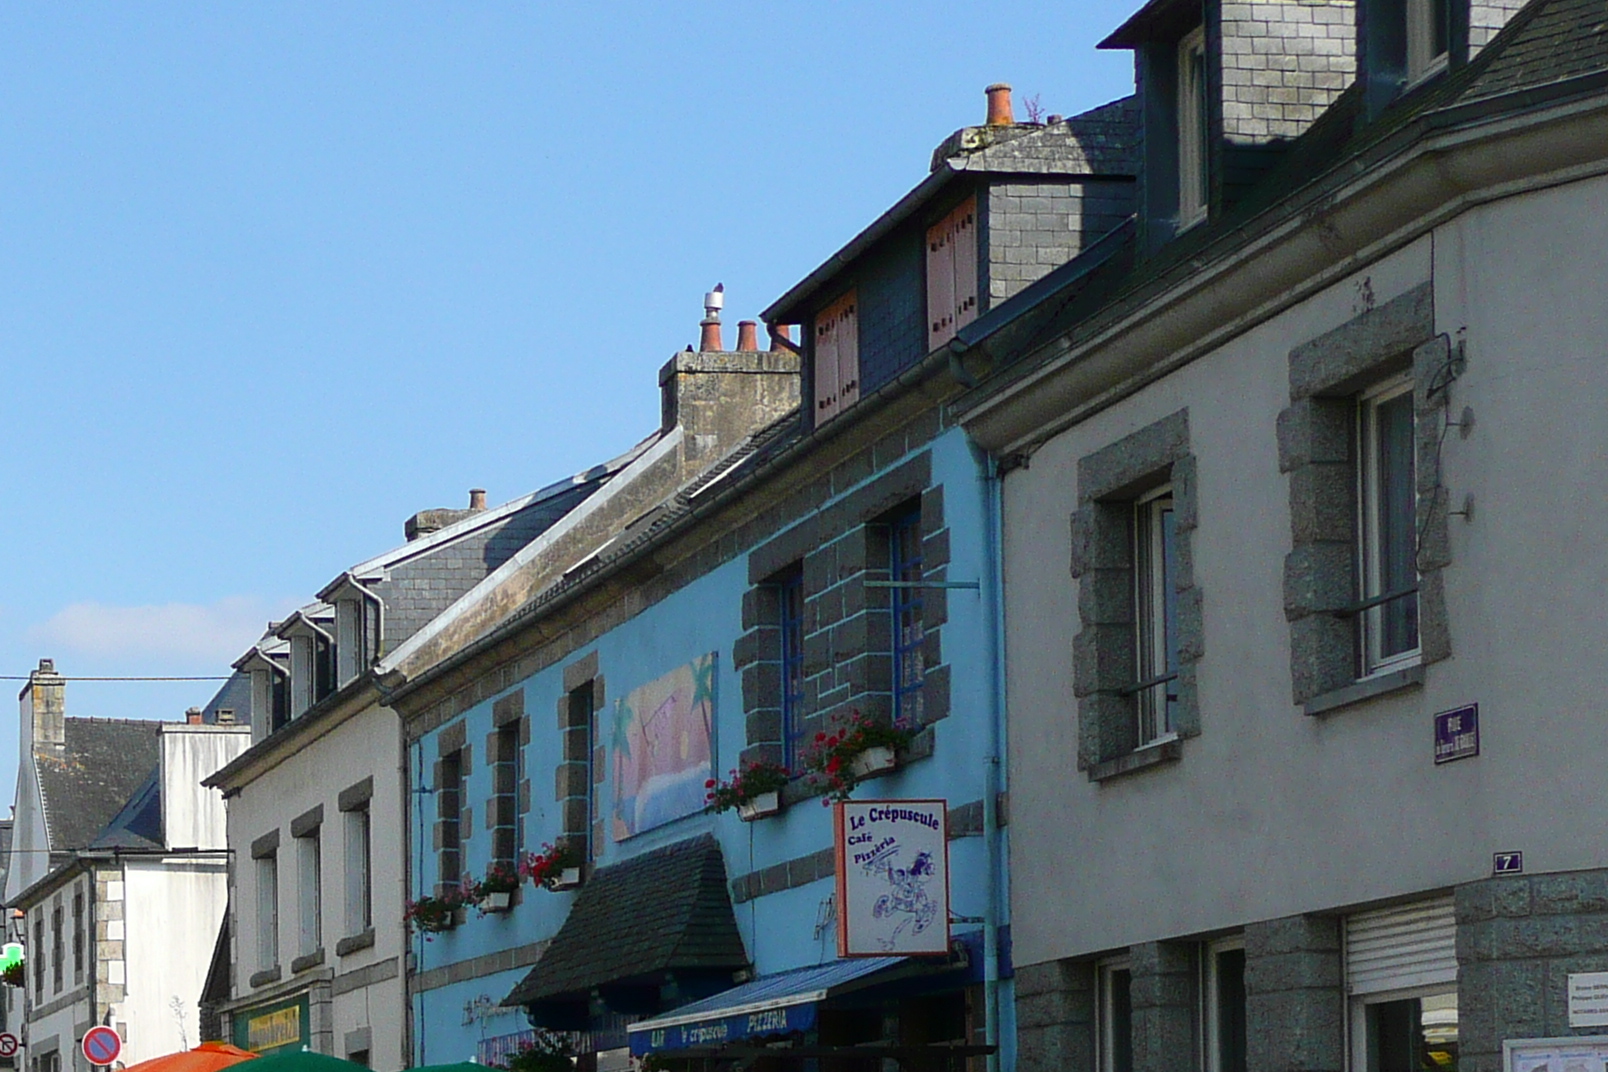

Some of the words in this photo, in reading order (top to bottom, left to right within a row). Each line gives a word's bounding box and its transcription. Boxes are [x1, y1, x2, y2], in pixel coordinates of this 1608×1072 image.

[849, 815, 865, 831] Le
[869, 805, 940, 831] Crépuscule
[847, 832, 873, 845] Café
[1502, 856, 1512, 870] 7
[747, 1010, 788, 1032] PIZZERIA
